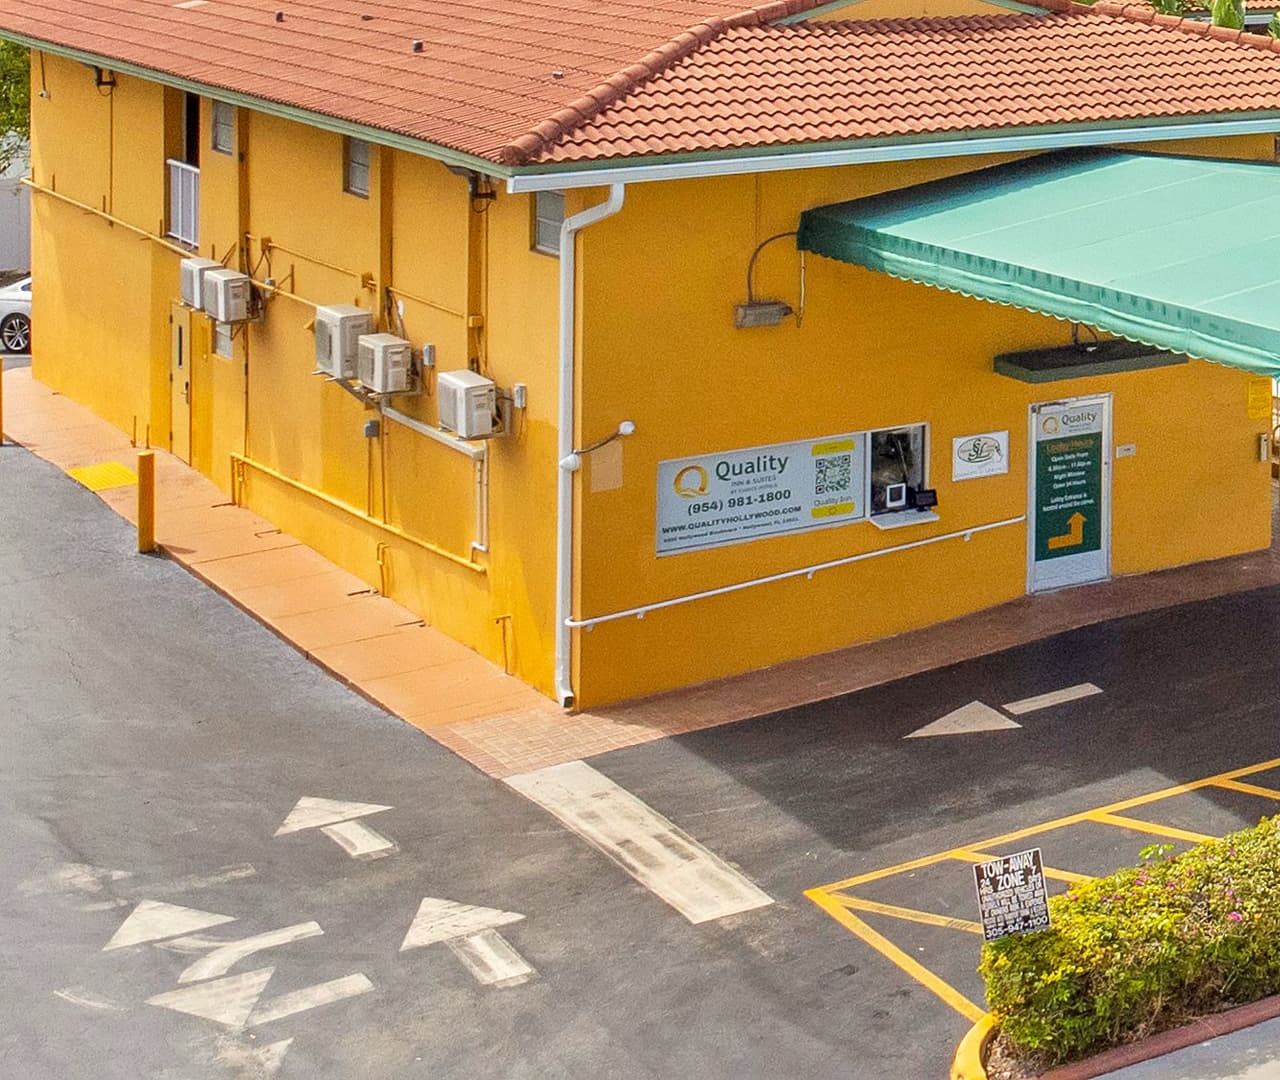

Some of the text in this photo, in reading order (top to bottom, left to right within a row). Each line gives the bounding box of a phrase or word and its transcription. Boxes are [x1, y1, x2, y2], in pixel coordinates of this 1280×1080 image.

[1062, 411, 1097, 425] Quality
[715, 455, 790, 481] Quality
[752, 474, 777, 484] SUITES
[687, 489, 791, 516] (954) 981-1800
[661, 505, 802, 534] WWW.QUALITYHOLLYWOOD.COM
[981, 852, 1034, 878] TOW-AWAY
[997, 870, 1025, 891] ZONE
[986, 915, 1048, 938] 305-947-1100
